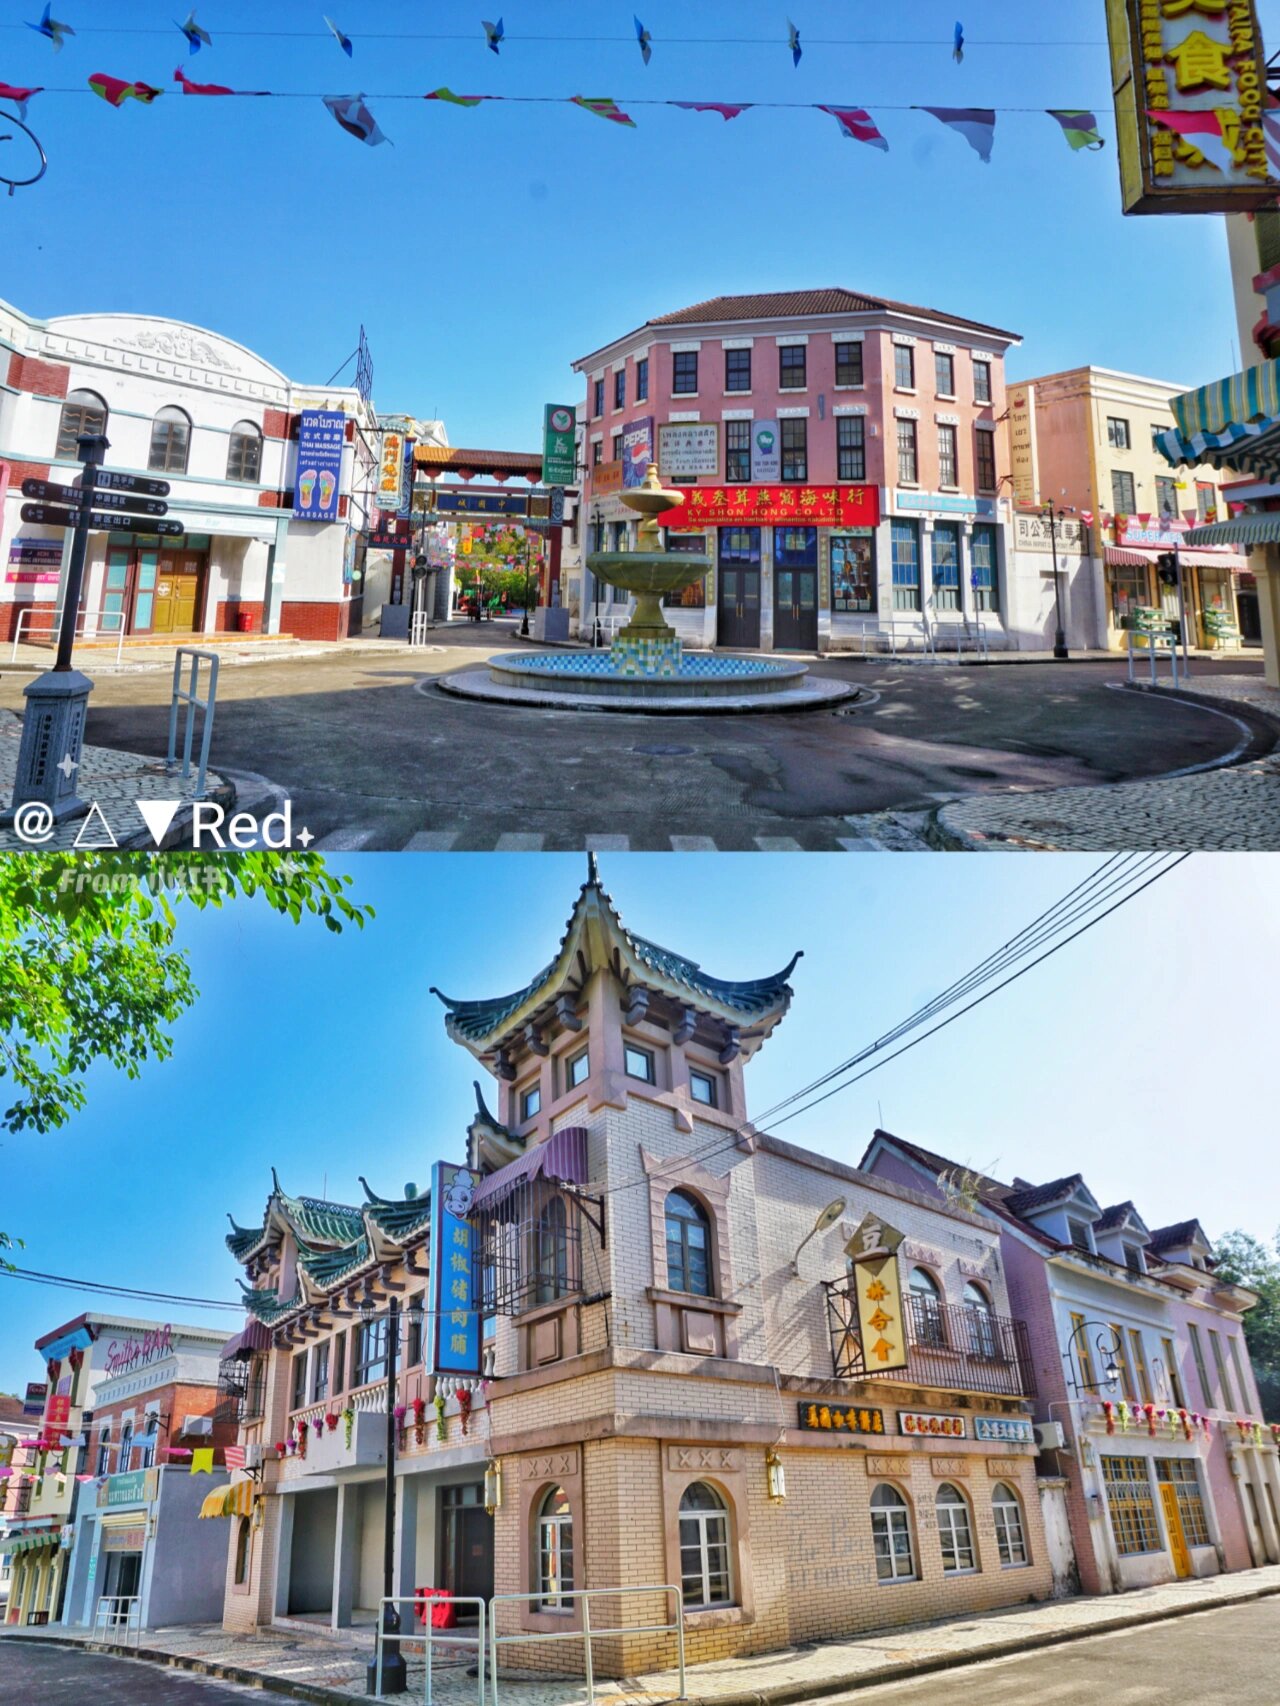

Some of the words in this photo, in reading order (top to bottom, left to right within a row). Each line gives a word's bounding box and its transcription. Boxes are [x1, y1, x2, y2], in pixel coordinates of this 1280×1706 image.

[624, 427, 649, 448] PEPSI
[315, 442, 340, 450] MASSAGE
[294, 511, 335, 519] MASSAGE
[688, 508, 701, 516] KY
[709, 508, 744, 516] SHON
[751, 508, 788, 516] HONG
[795, 508, 811, 516] CO
[820, 508, 844, 516] LTD
[855, 1224, 890, 1259] 豆
[143, 1323, 172, 1356] BAR
